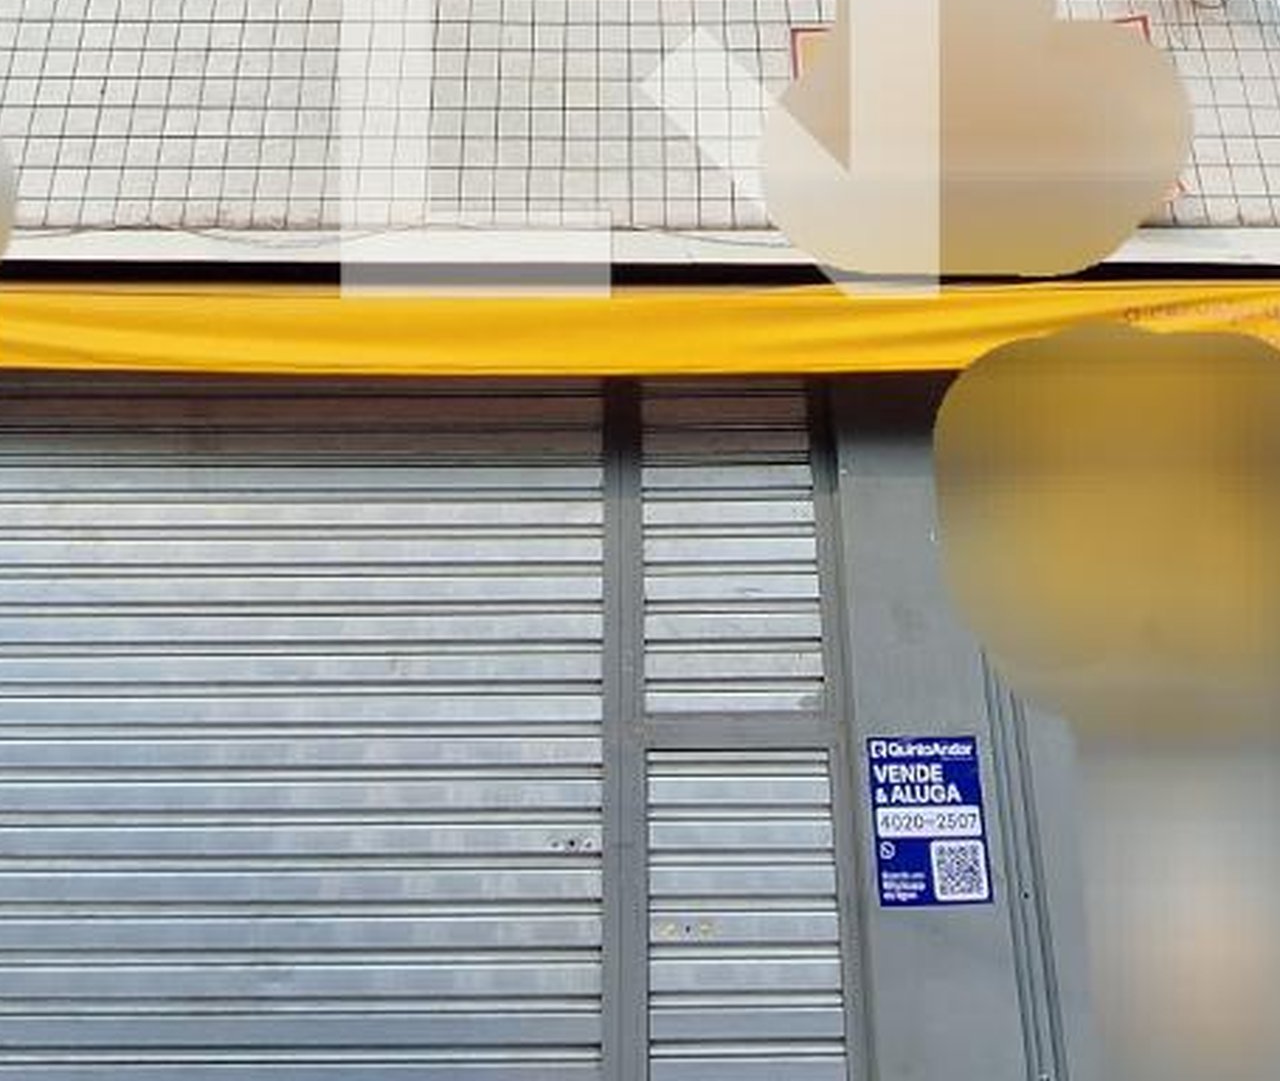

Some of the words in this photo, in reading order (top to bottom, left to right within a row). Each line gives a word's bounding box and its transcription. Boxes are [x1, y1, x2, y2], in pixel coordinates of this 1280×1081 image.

[873, 764, 943, 783] VENDE
[875, 787, 888, 803] &
[891, 783, 962, 803] ALUGA
